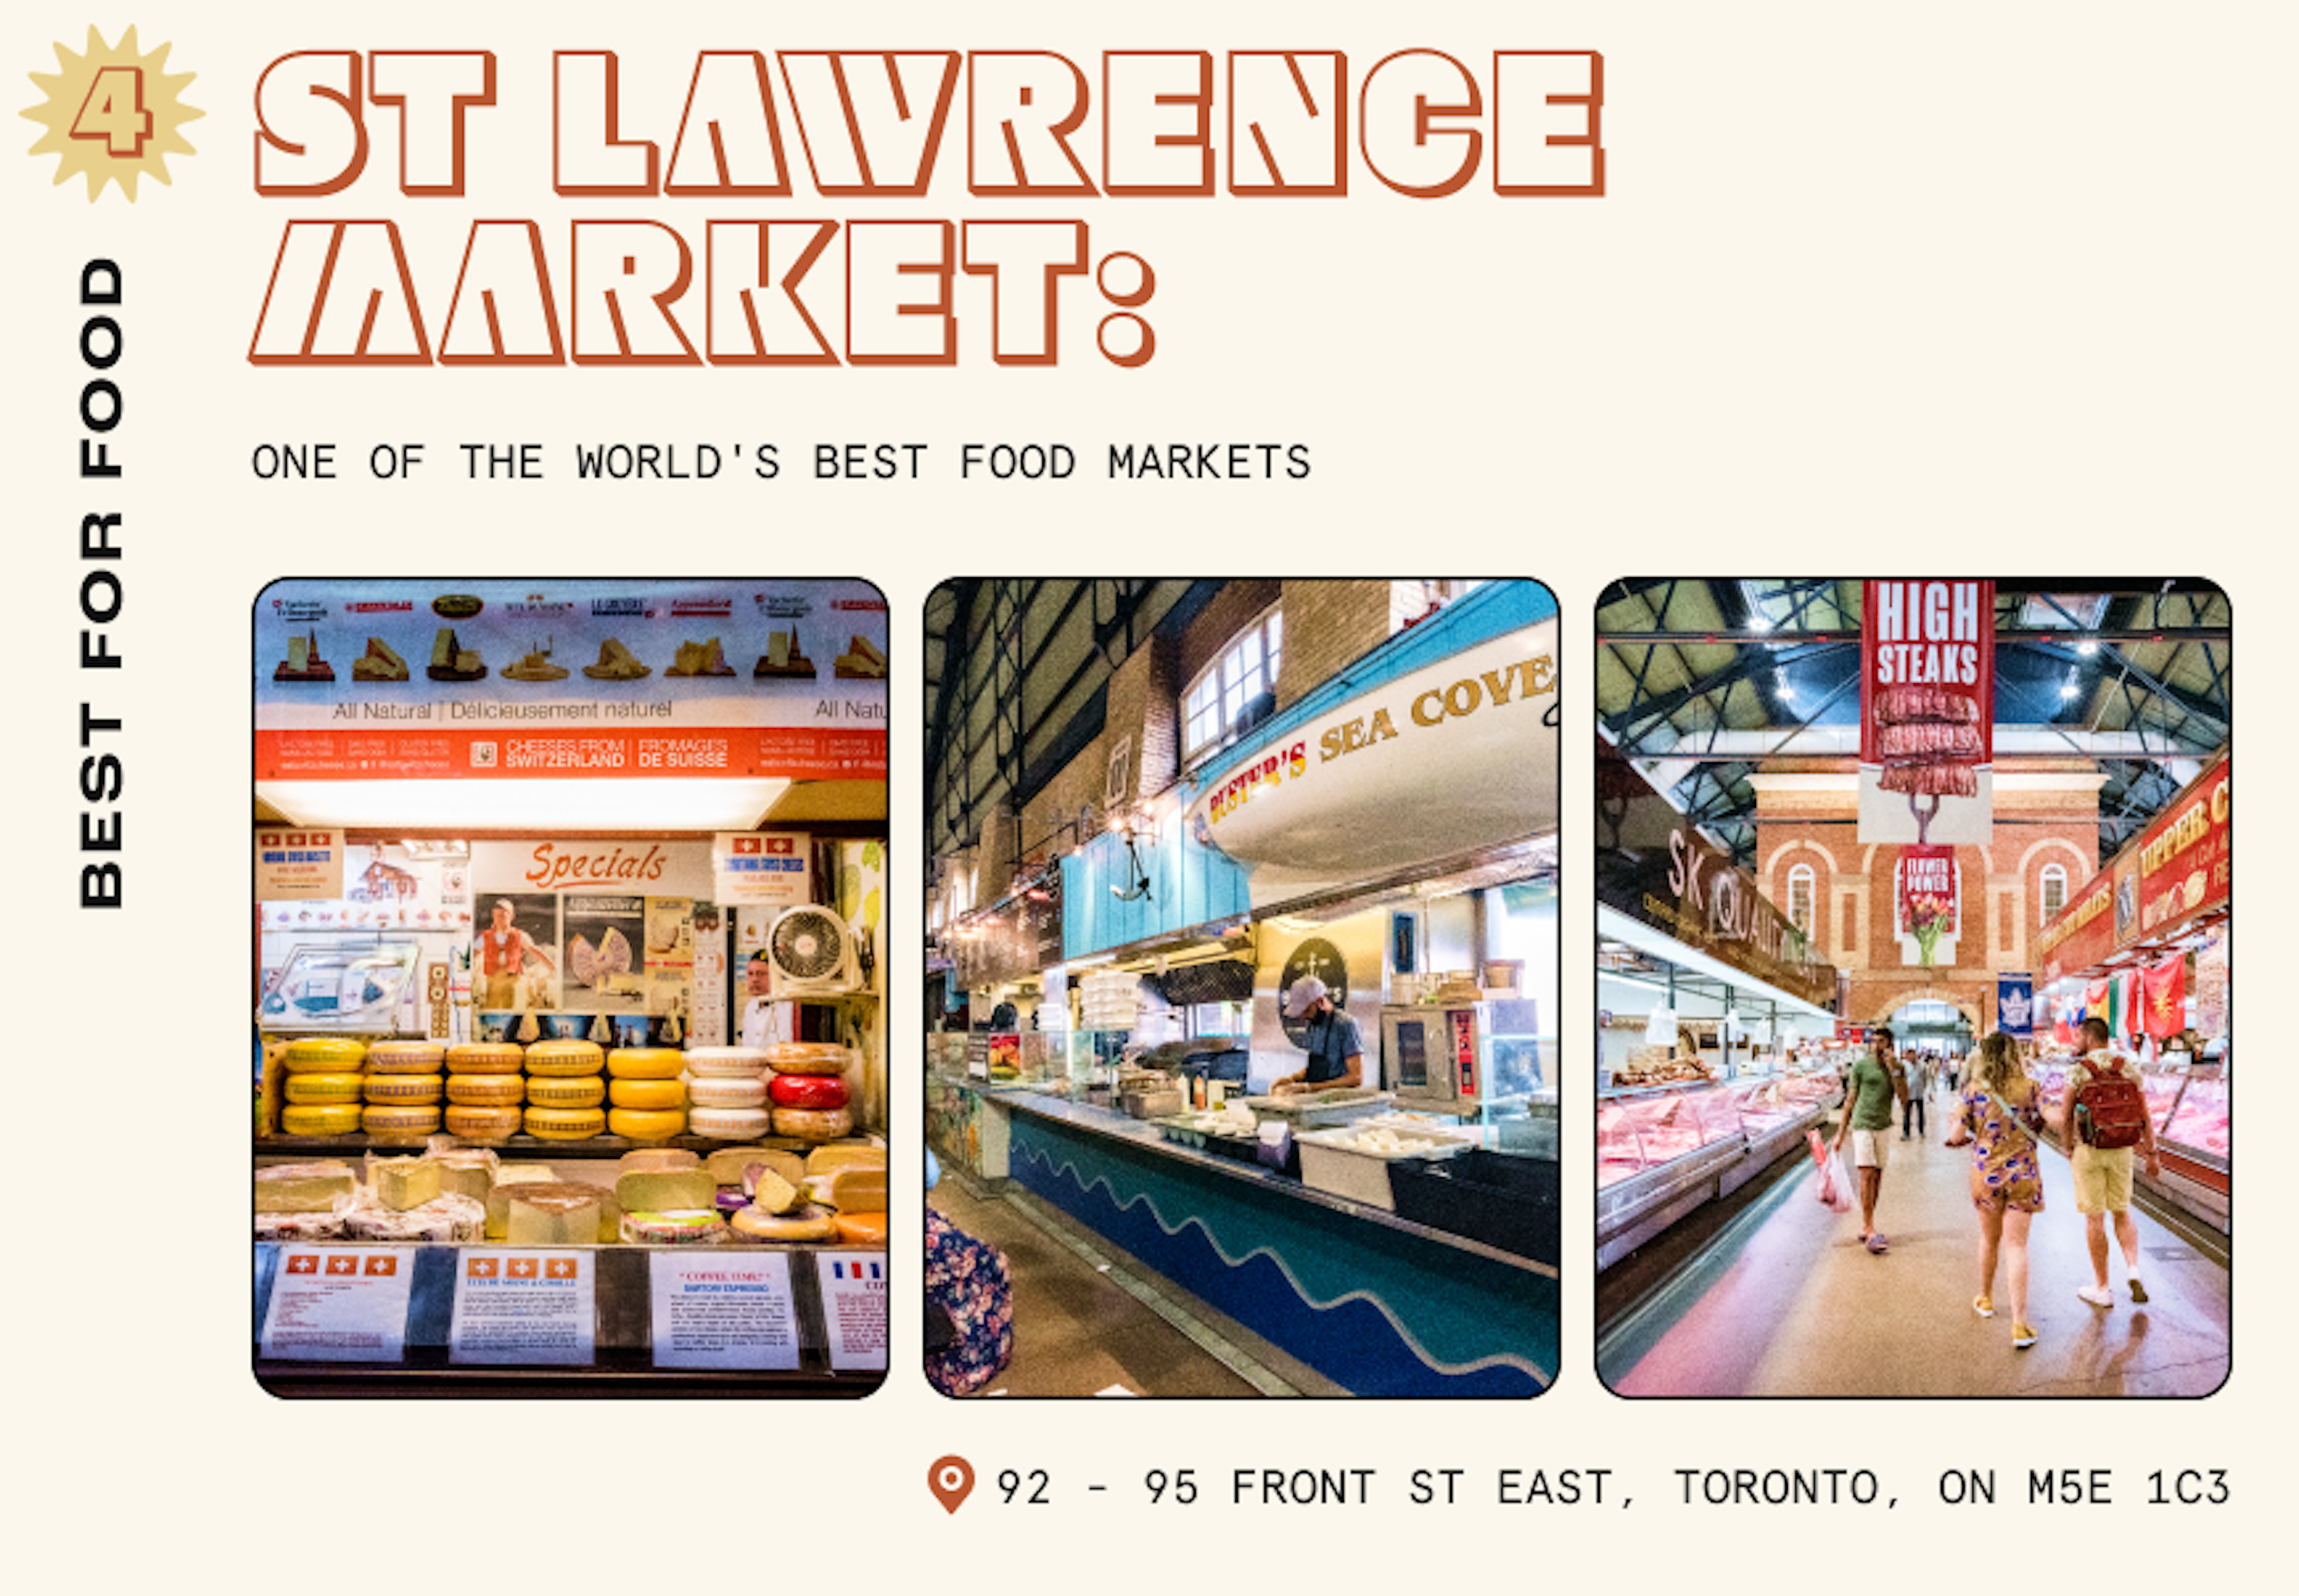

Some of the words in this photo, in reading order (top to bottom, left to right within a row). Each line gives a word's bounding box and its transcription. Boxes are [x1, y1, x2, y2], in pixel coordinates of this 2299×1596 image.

[1878, 582, 1978, 641] HIGH
[1878, 644, 1978, 684] STEAKS
[333, 702, 357, 719] All
[364, 702, 432, 719] Natural
[605, 700, 672, 719] naturel
[815, 699, 838, 718] All
[1319, 708, 1399, 762] SEA
[1410, 653, 1557, 727] COVE
[506, 739, 576, 753] CHEESES
[578, 739, 624, 753] FROM
[638, 739, 729, 754] FROMAGES
[506, 753, 624, 767] SWITZERLAND
[638, 753, 662, 767] DE
[667, 753, 728, 767] SUISSE
[2140, 799, 2210, 878] UPPER
[526, 842, 667, 888] Specials
[1907, 857, 1949, 874] FLOWER
[1907, 875, 1949, 892] POWER
